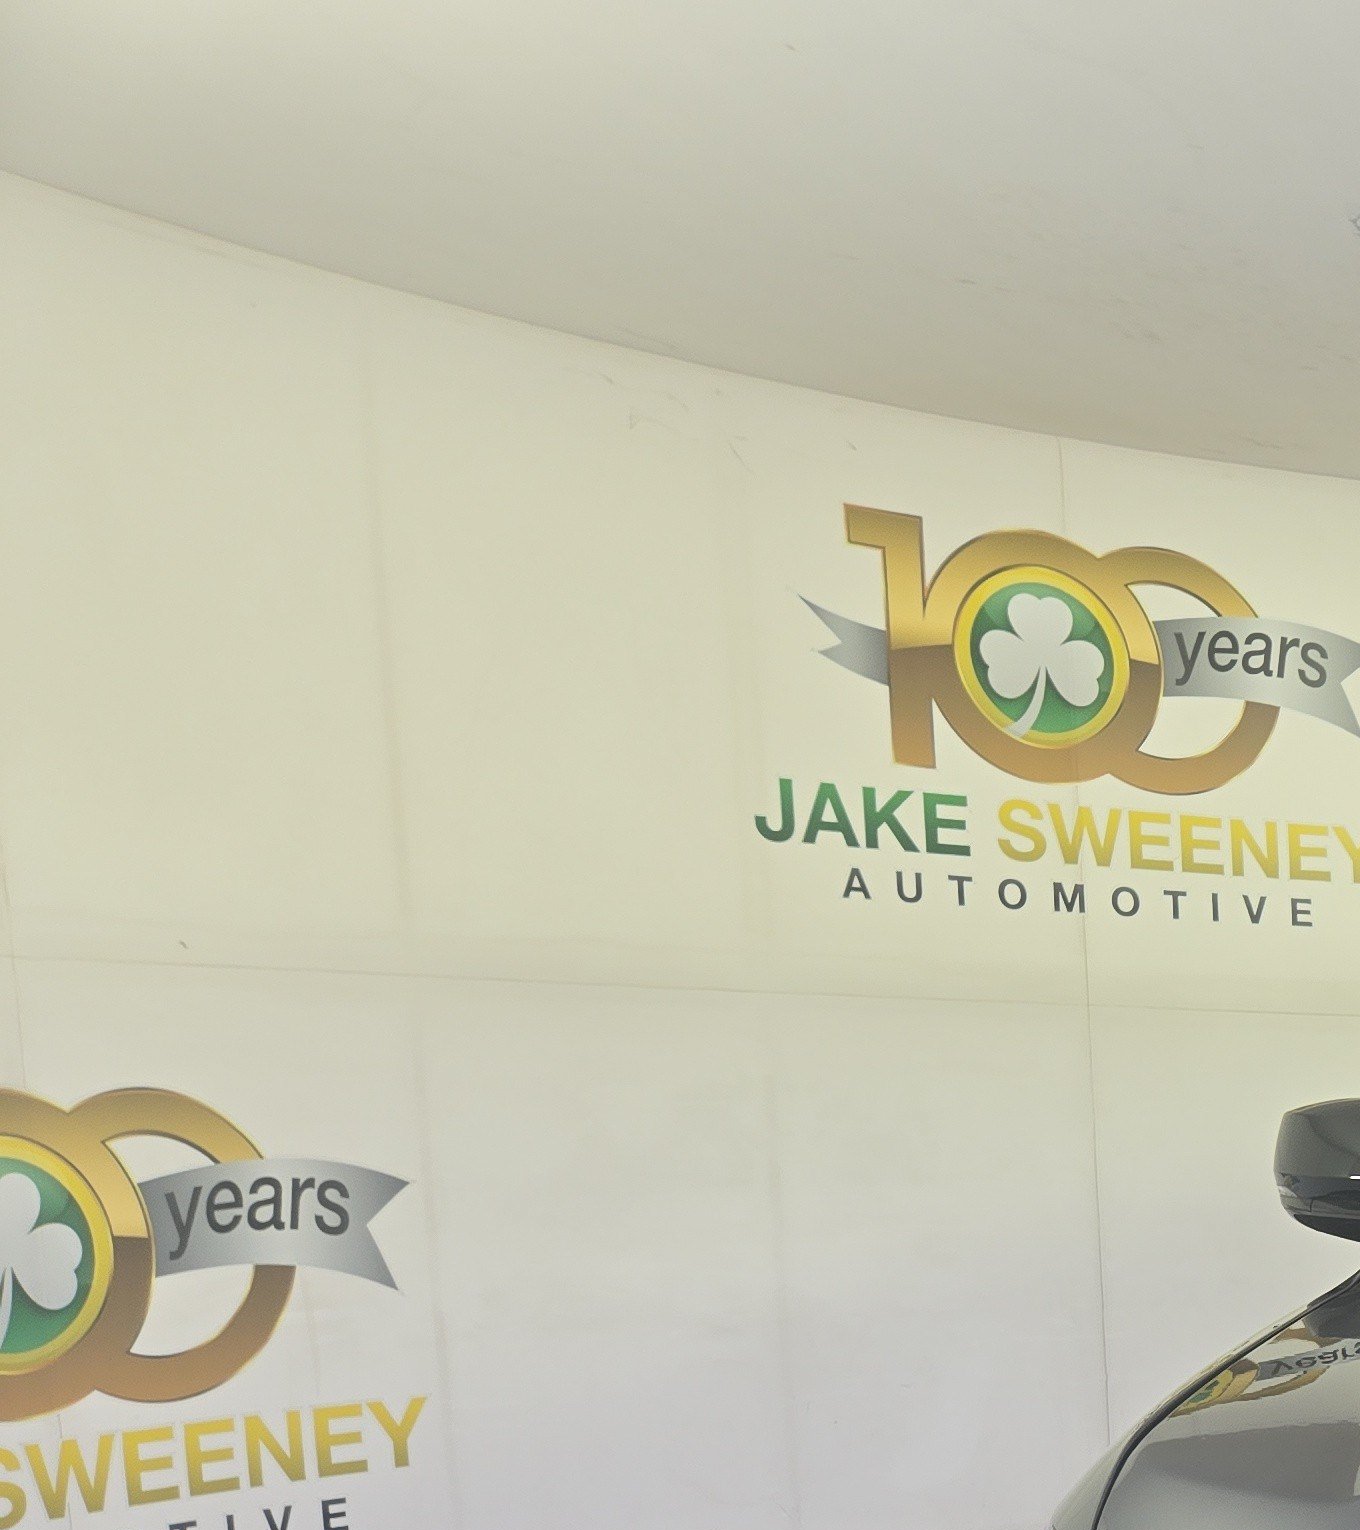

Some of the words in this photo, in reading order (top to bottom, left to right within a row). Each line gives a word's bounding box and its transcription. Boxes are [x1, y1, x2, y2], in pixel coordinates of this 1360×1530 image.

[1174, 625, 1329, 688] years
[754, 778, 972, 857] JAKE
[843, 867, 1314, 927] AUTOMOTIVE
[164, 1172, 350, 1260] years
